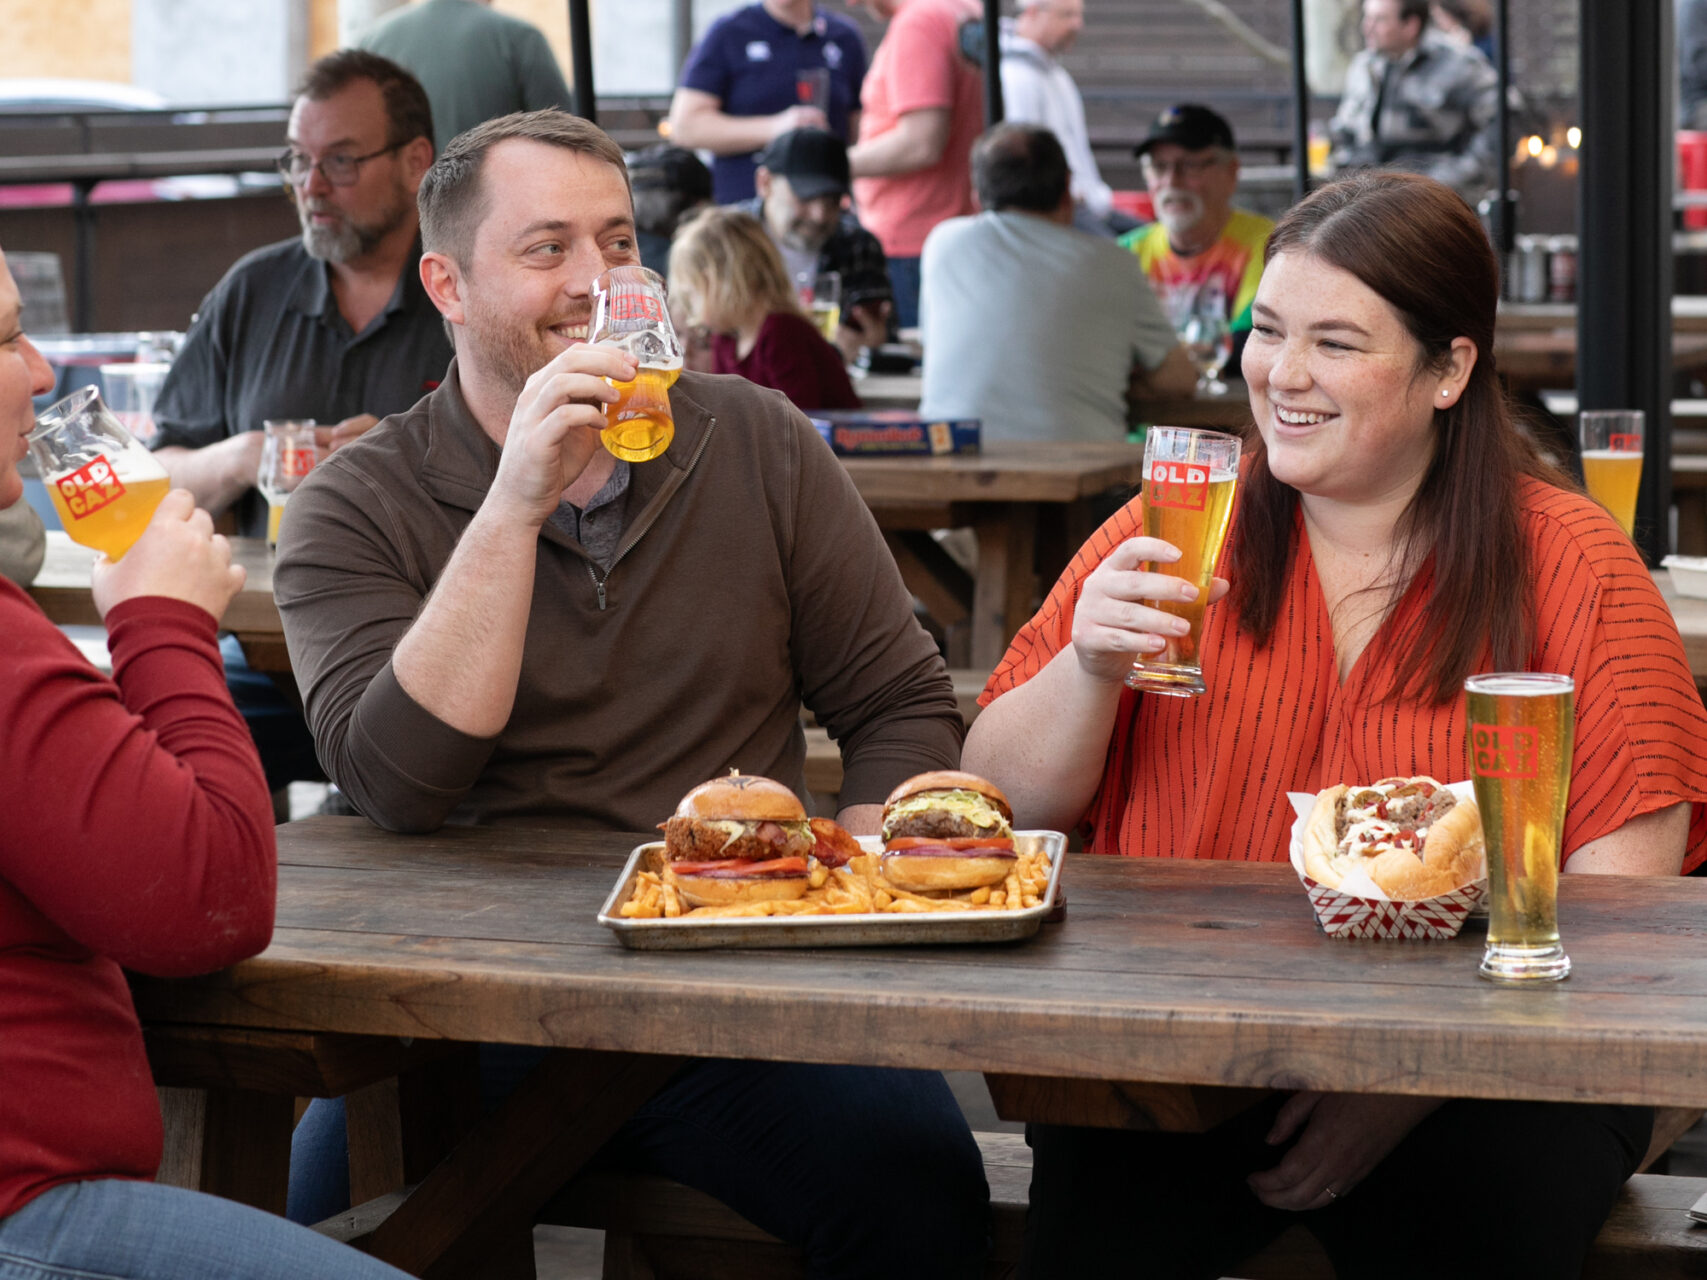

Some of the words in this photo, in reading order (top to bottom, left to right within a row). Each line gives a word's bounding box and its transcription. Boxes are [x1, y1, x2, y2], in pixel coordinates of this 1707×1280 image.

[616, 296, 658, 309] OLD
[62, 462, 109, 498] OLD
[1153, 466, 1206, 484] OLD
[69, 475, 120, 515] CAZ
[1152, 484, 1203, 507] CAZ
[1475, 730, 1533, 751] OLD
[1477, 750, 1533, 773] CAZ
